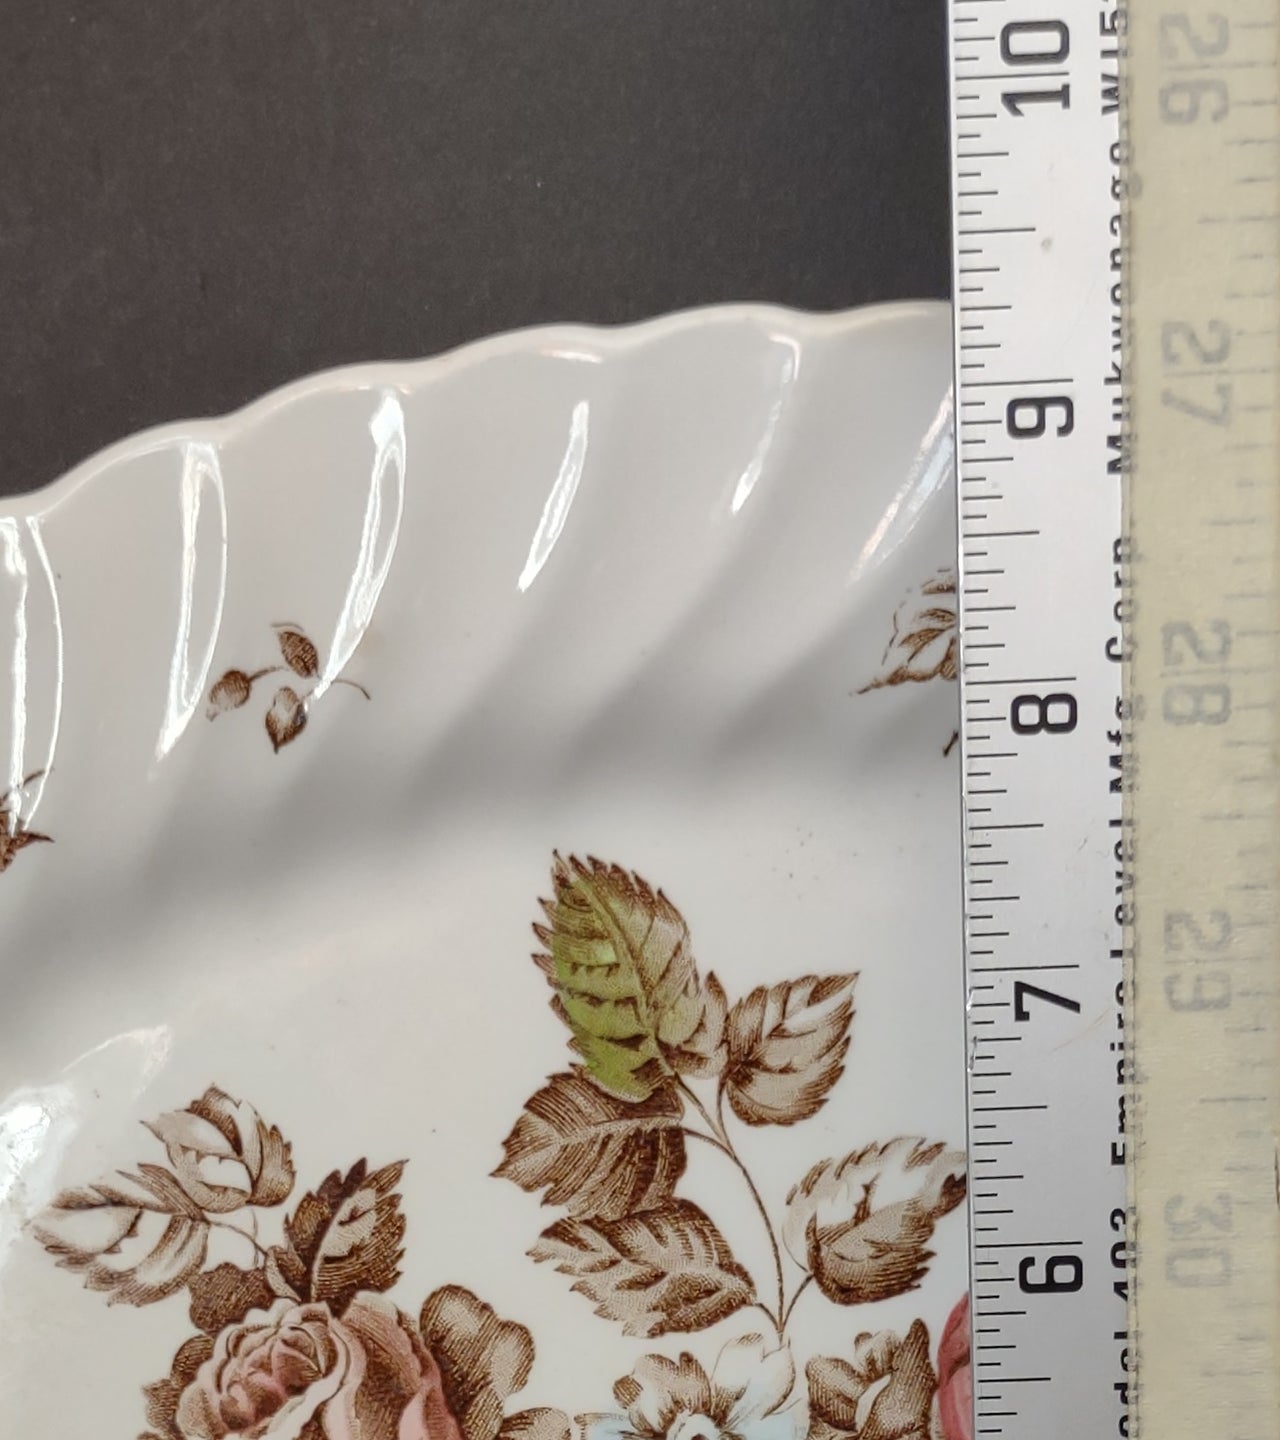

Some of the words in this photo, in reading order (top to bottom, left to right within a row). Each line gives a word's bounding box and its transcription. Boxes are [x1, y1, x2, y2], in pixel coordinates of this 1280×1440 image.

[1000, 19, 1070, 119] 10
[1159, 13, 1231, 125] 26
[1007, 395, 1074, 439] 9
[1162, 318, 1232, 426] 27
[1010, 692, 1079, 735] 8
[1161, 619, 1232, 728] 28
[1014, 979, 1082, 1022] 7
[1163, 910, 1232, 1014] 29
[1018, 1254, 1084, 1295] 6
